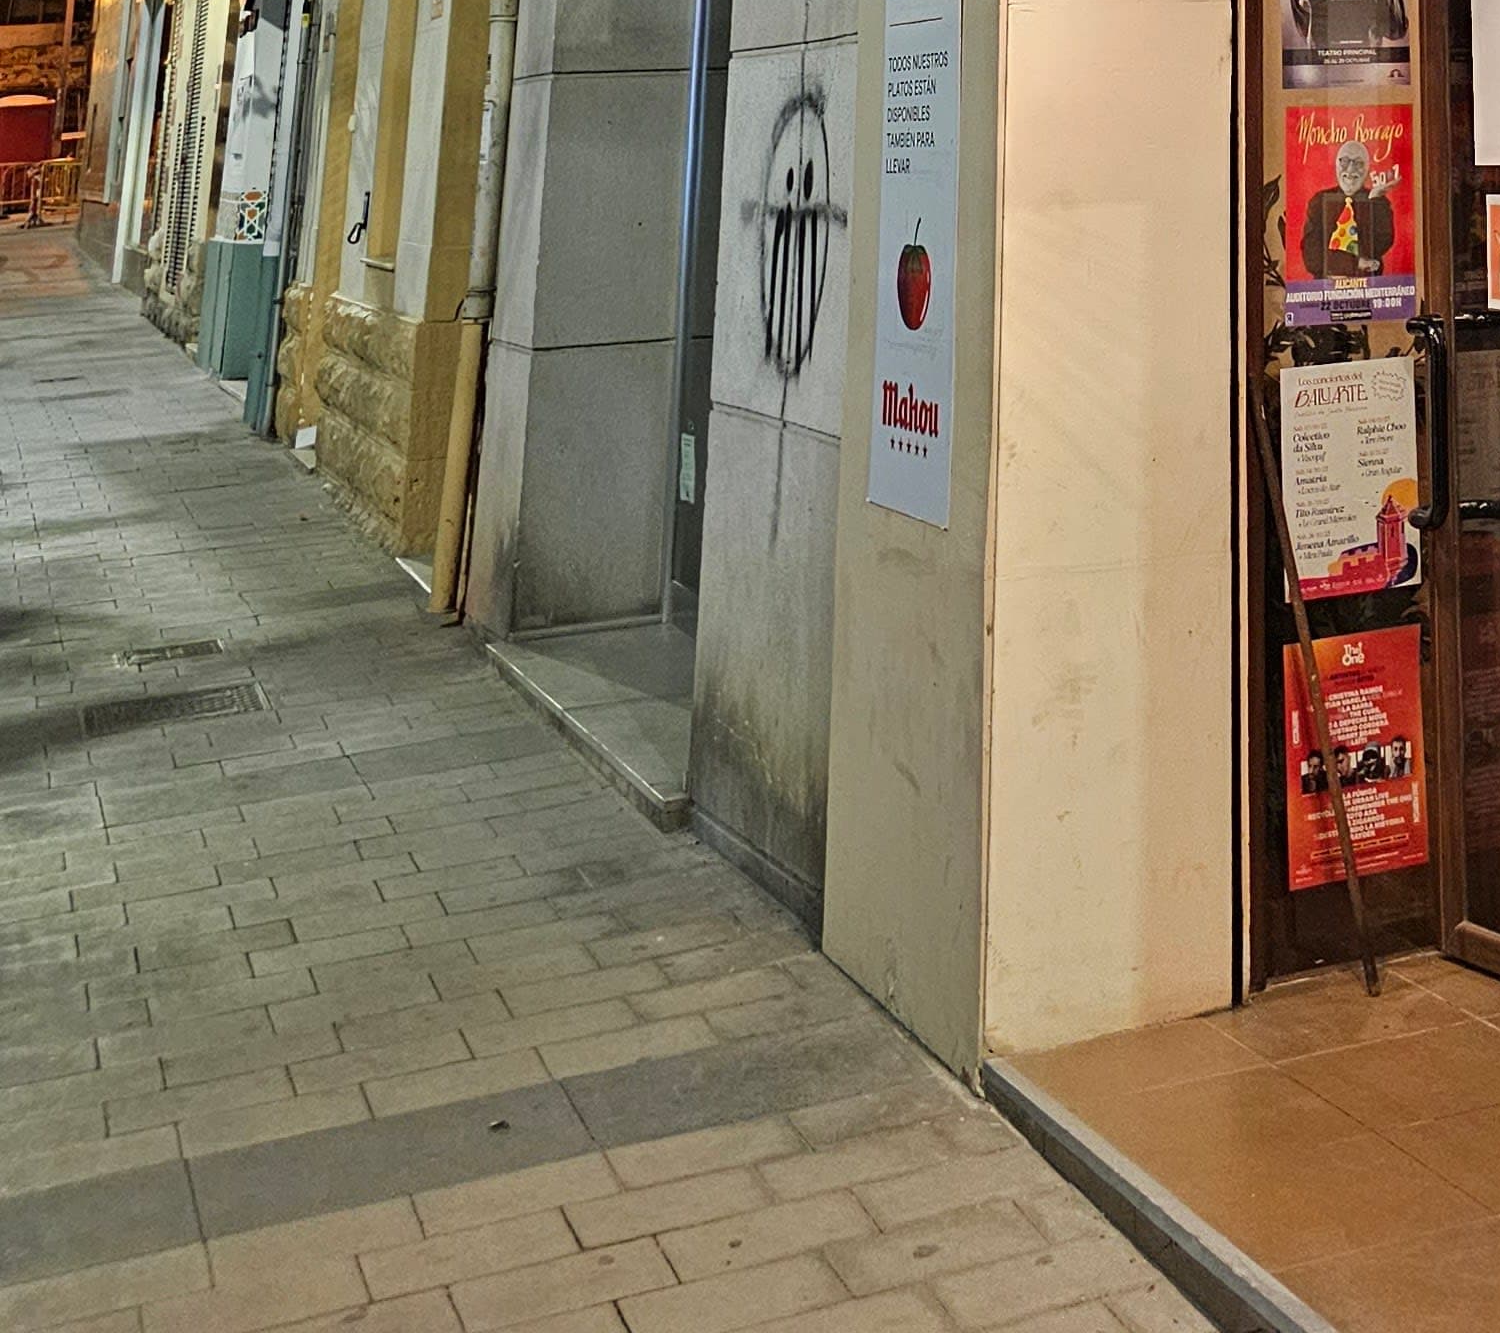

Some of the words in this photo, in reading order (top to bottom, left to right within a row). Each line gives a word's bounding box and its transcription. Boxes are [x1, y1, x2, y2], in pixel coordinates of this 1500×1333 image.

[889, 55, 912, 74] TODOS
[912, 50, 949, 71] NUESTROS
[888, 80, 914, 99] PLATOS
[914, 74, 937, 96] ESTÁN
[887, 104, 931, 124] DISPONIBLES
[887, 127, 917, 149] TAMBIÉN
[917, 131, 936, 148] PARA
[1296, 111, 1347, 166] Moncho
[885, 158, 911, 175] LLEVAR
[1286, 291, 1323, 303] AUDITORIO
[1323, 288, 1364, 301] FUNDACIÓN
[1365, 285, 1415, 299] MEDITERRÁNEO
[1334, 277, 1368, 290] ALICANTE
[1320, 301, 1331, 311] 22
[1332, 299, 1371, 310] OCTUBRE
[1294, 383, 1368, 408] BALUARTE
[882, 379, 940, 438] Mahou
[1342, 652, 1365, 666] One
